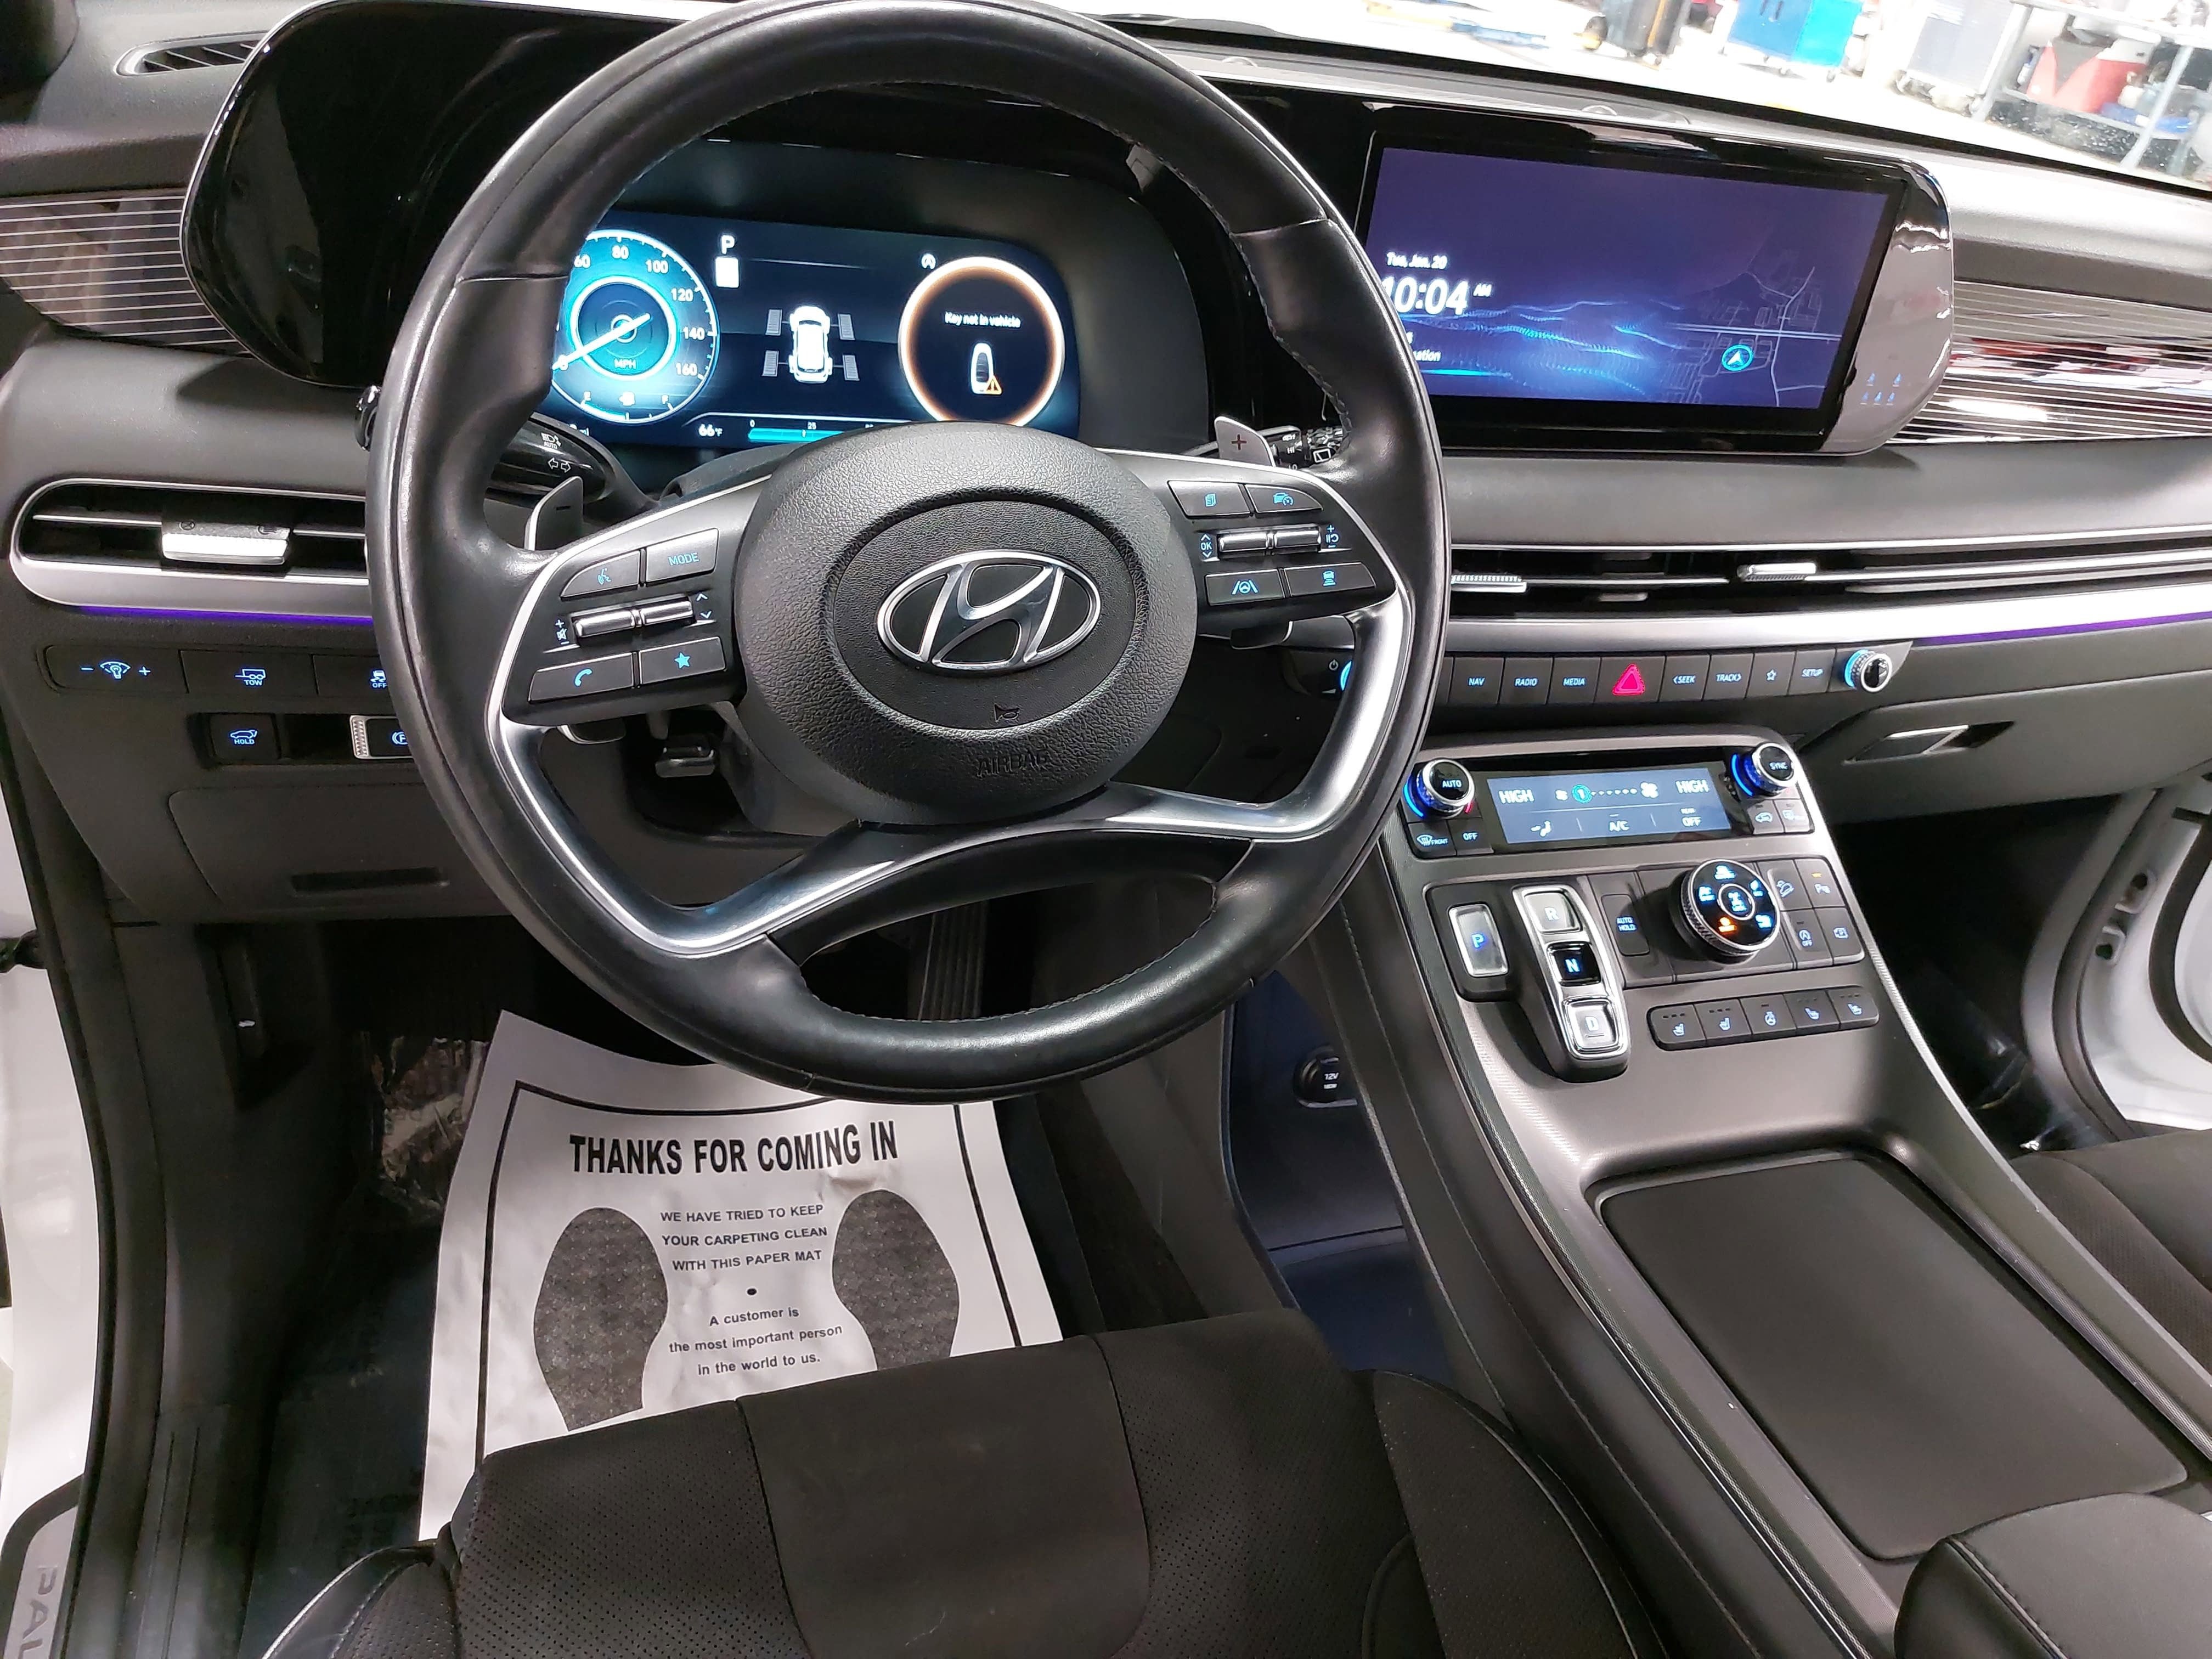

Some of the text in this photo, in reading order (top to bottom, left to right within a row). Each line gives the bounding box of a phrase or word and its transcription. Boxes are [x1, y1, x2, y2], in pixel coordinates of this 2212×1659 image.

[612, 245, 629, 259] 80
[721, 235, 735, 255] P
[574, 254, 591, 268] 60
[646, 259, 669, 273] 100
[1431, 255, 1448, 269] 20
[671, 288, 693, 302] 120
[1381, 276, 1492, 315] 10:04 AM
[945, 311, 962, 326] Key
[963, 313, 979, 325] not
[989, 314, 1021, 328] vehicle
[682, 327, 705, 340] 140
[614, 358, 636, 369] MPH
[675, 363, 697, 376] 160
[808, 422, 817, 430] 25
[1200, 541, 1212, 550] OK
[667, 552, 699, 566] MODE
[1802, 669, 1824, 678] SETUP
[1468, 678, 1486, 686] NAV
[1514, 678, 1538, 686] RADIO
[1563, 677, 1586, 686] MEDIA
[1769, 761, 1788, 770] SYNC
[1442, 780, 1462, 788] AUTO
[1498, 789, 1535, 804] HIGH
[1675, 779, 1709, 794] HIGH
[1681, 816, 1702, 827] OFF
[1463, 832, 1479, 841] OFF
[1544, 907, 1560, 922] R
[1472, 934, 1485, 948] P
[1566, 959, 1579, 972] N
[1585, 1016, 1599, 1031] D
[1324, 1072, 1339, 1080] 12V
[569, 1120, 898, 1175] THANKS FOR COMING IN
[660, 1204, 824, 1222] WE HAVE TRIED TO KEEP
[662, 1227, 828, 1246] YOUR CARPETING CLEAN
[672, 1250, 822, 1271] WITH THIS PAPER MAT
[709, 1307, 800, 1327] A customer is
[669, 1325, 843, 1353] the most important person
[697, 1353, 821, 1375] in the world to us.
